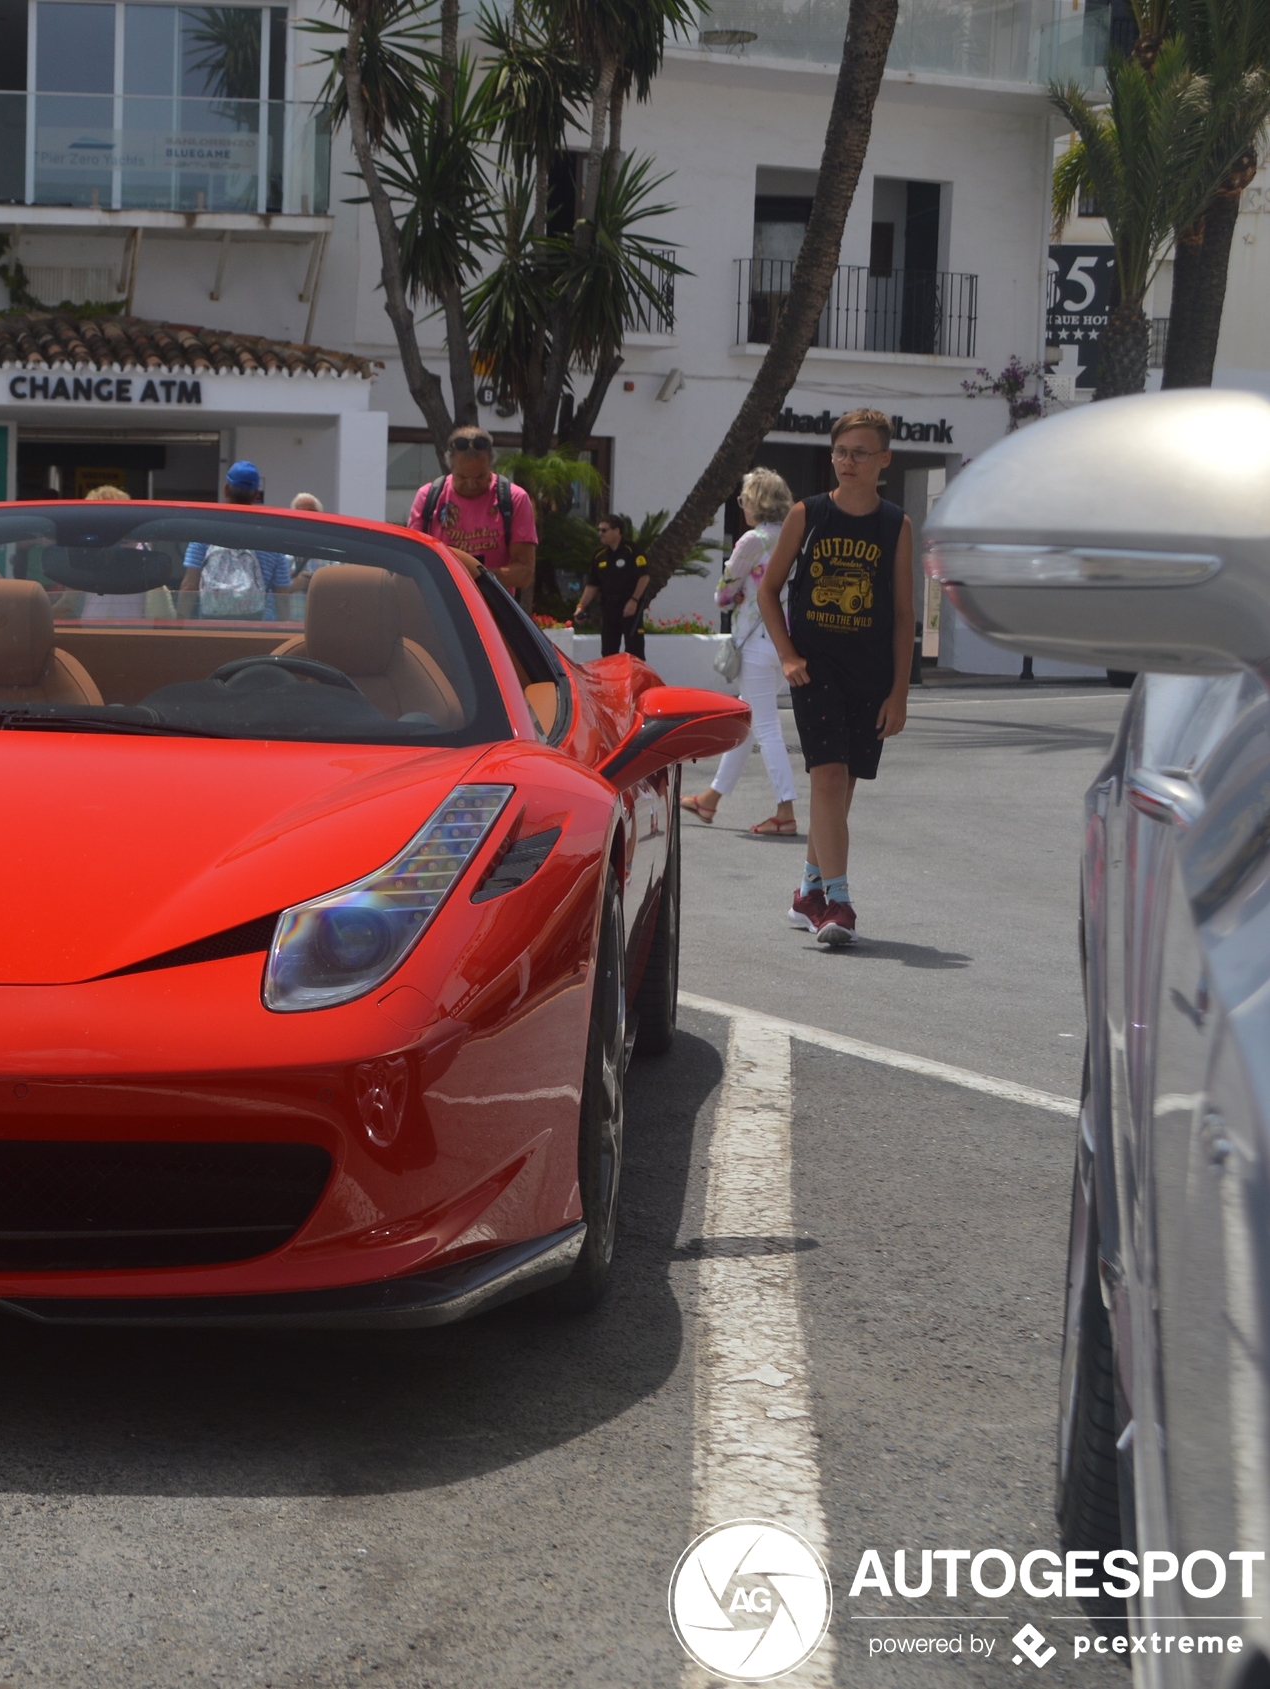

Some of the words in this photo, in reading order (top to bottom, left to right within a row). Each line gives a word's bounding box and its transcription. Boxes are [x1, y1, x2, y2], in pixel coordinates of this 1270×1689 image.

[41, 153, 64, 165] Pier
[70, 153, 99, 166] Zero
[104, 154, 145, 167] Yachts
[166, 148, 230, 159] BLUEGAME
[9, 376, 132, 401] CHANGE
[140, 379, 202, 404] ATM
[836, 614, 851, 626] THE
